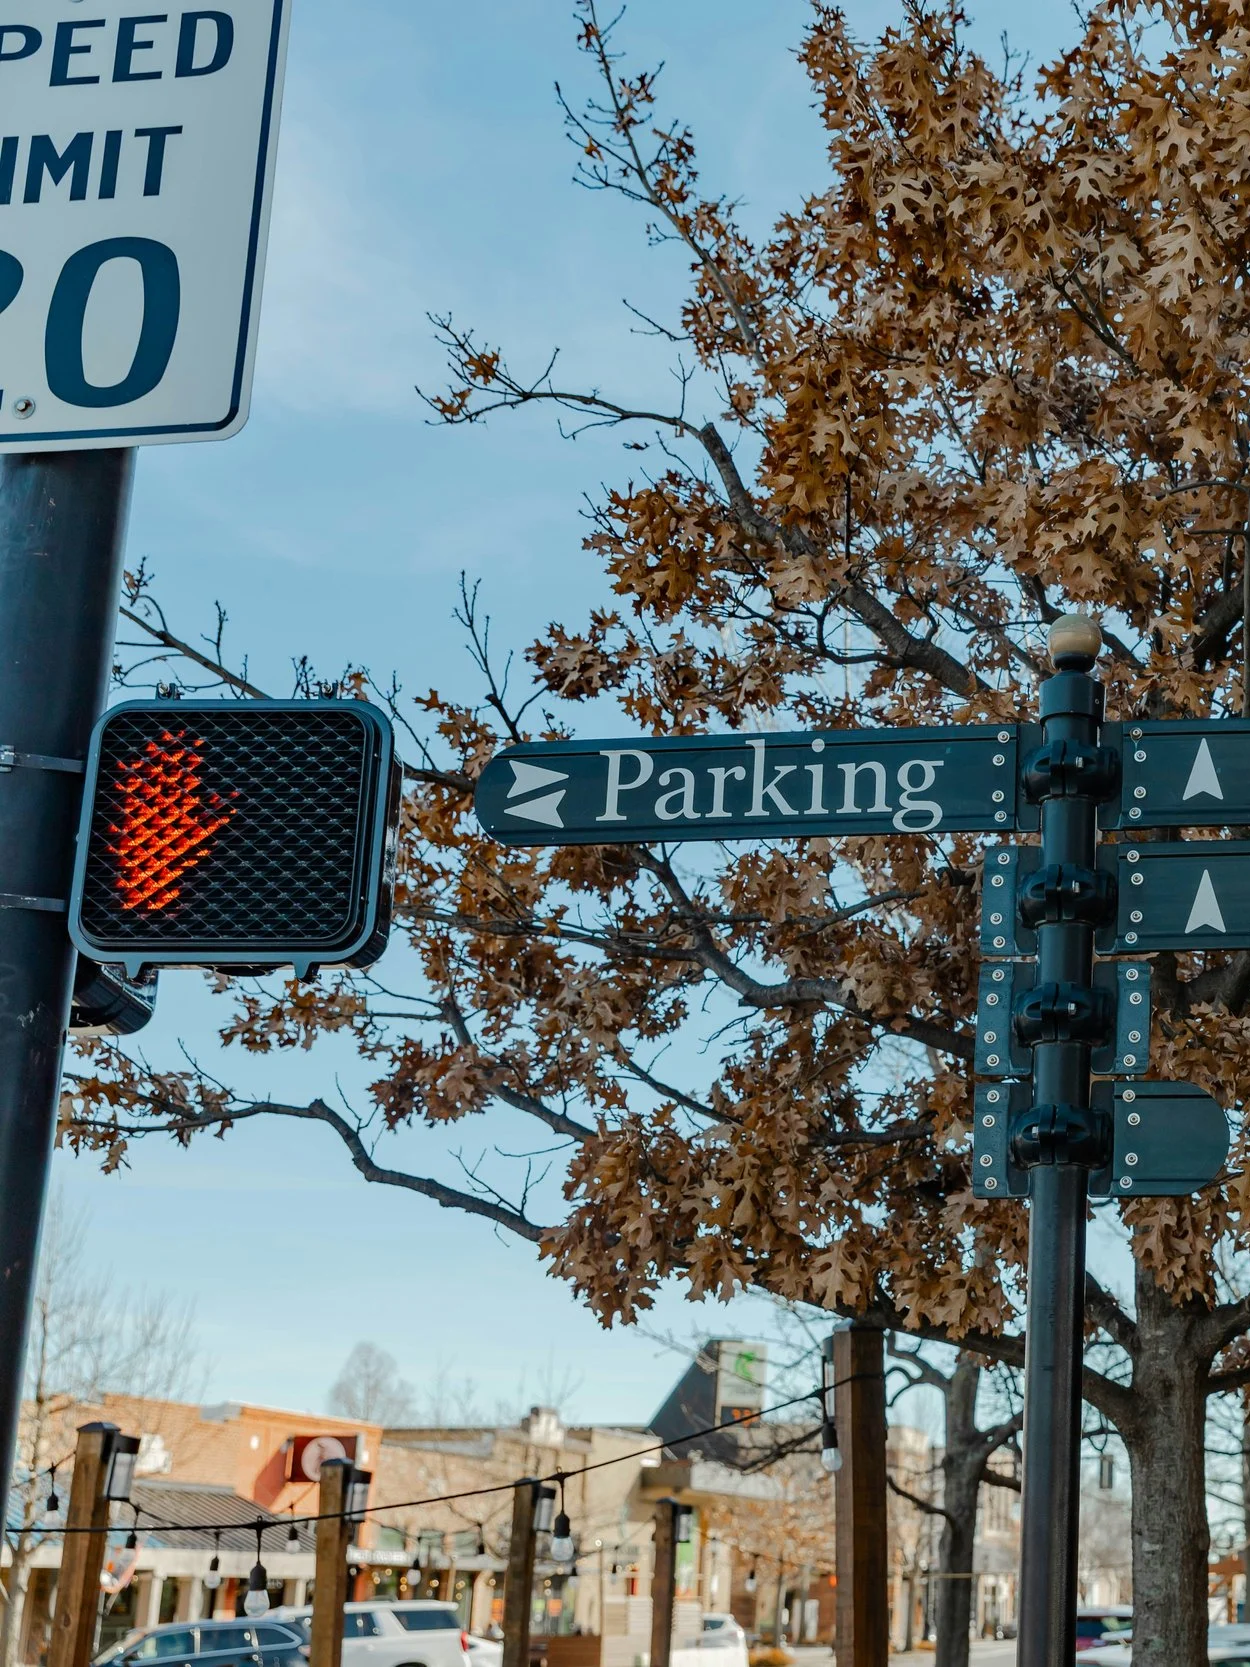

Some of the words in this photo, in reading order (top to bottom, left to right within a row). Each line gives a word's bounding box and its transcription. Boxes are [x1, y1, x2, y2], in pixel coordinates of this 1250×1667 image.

[0, 10, 234, 87] PEED
[0, 124, 184, 205] IMIT
[595, 738, 944, 832] Parking
